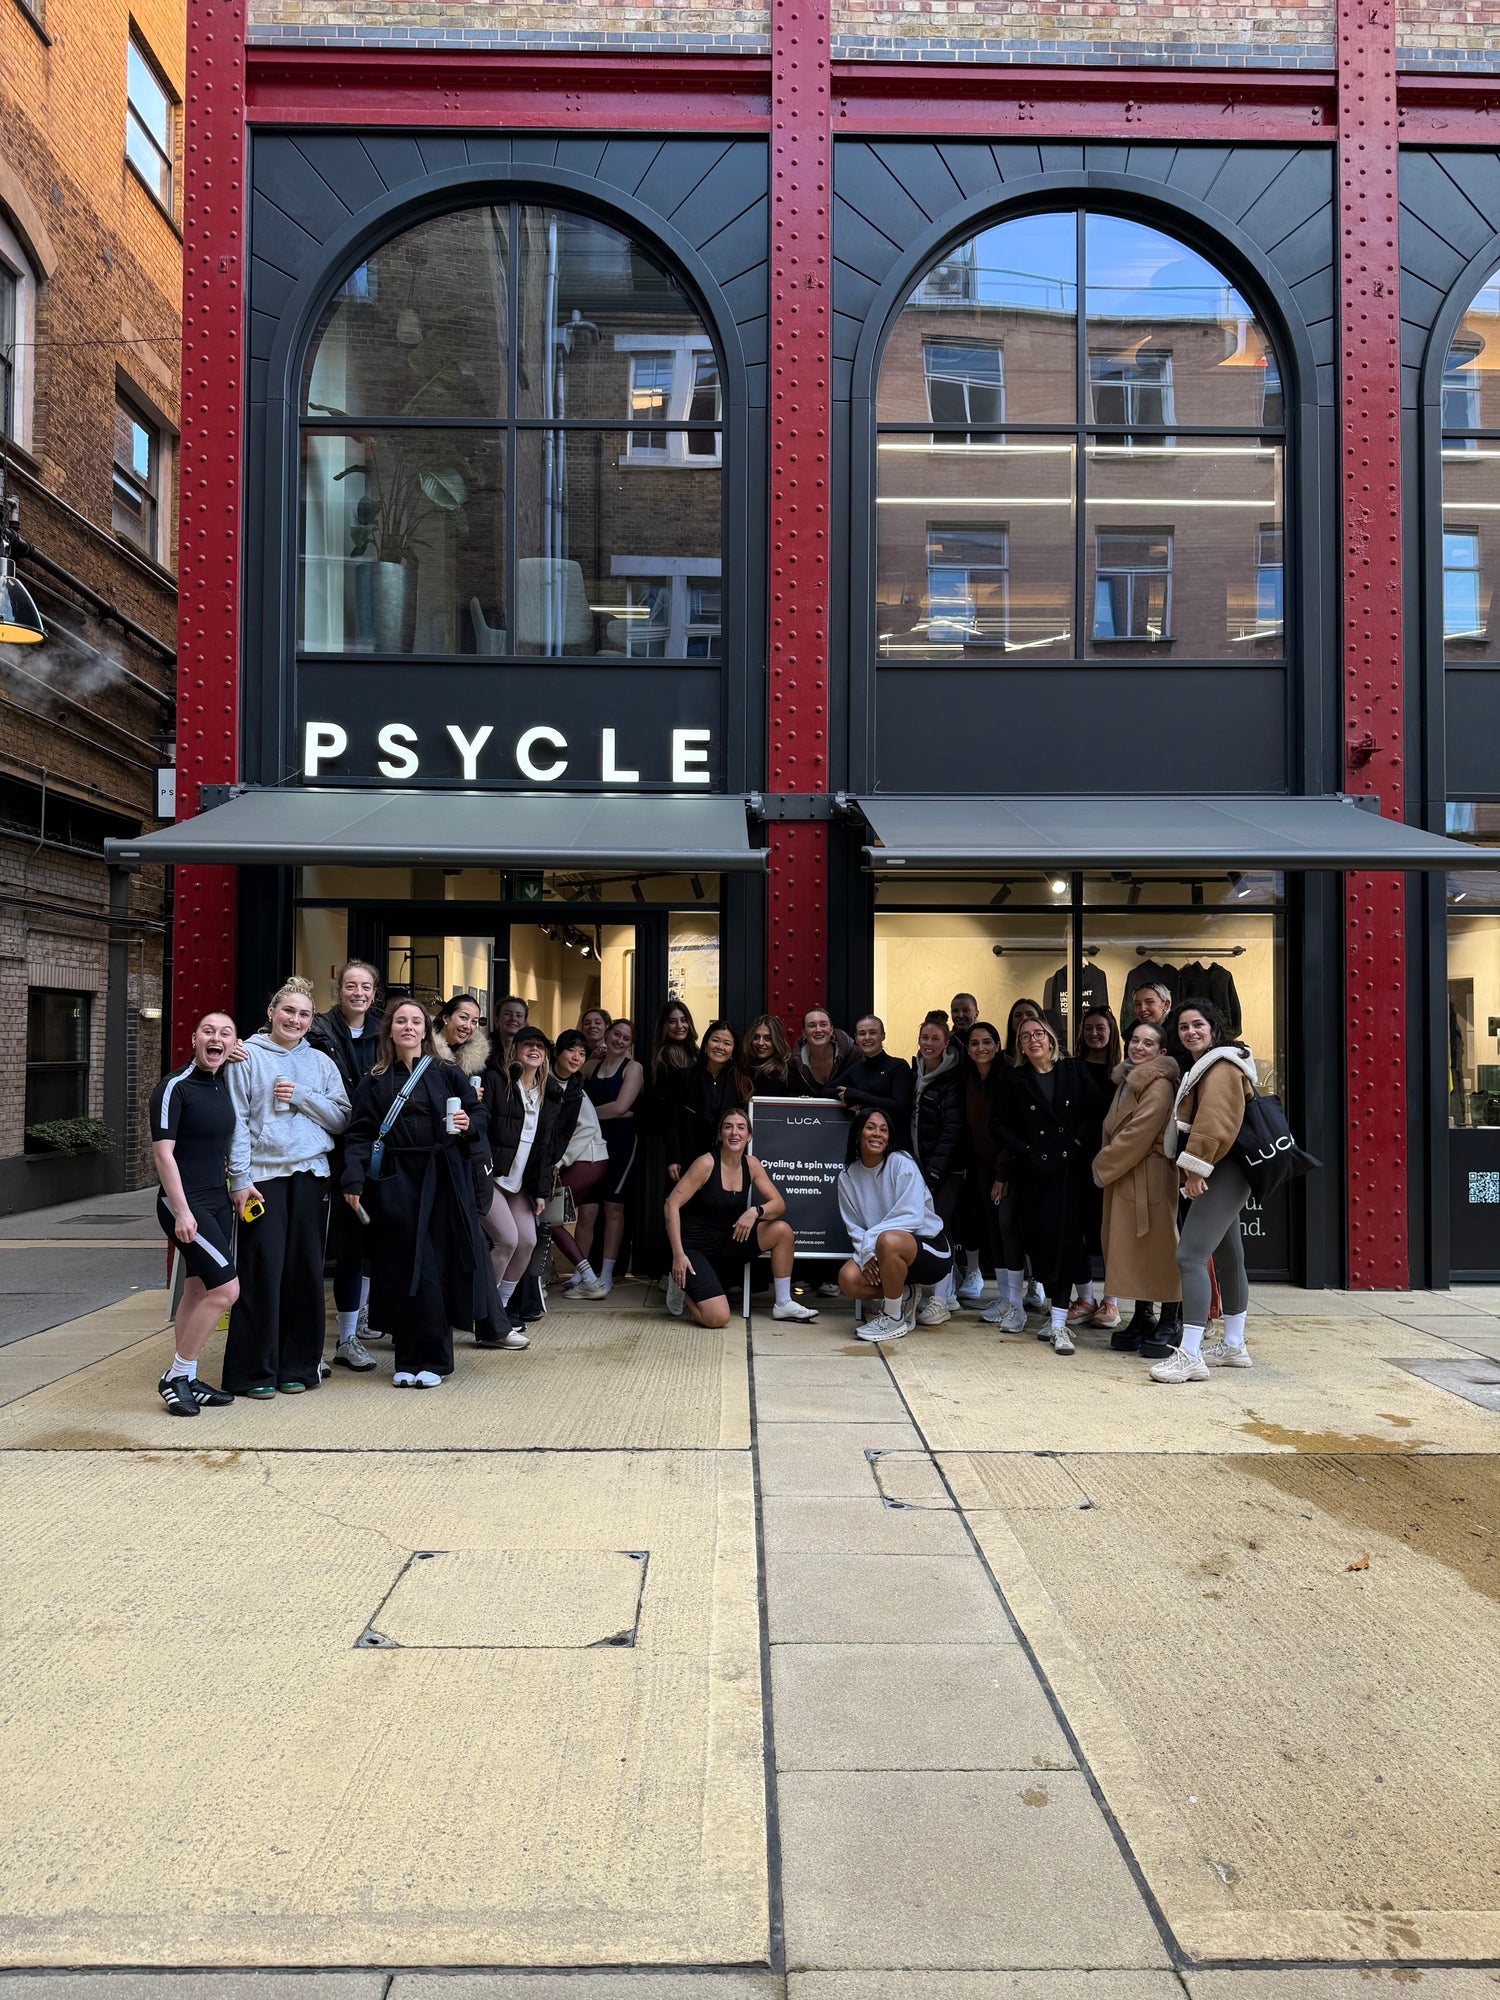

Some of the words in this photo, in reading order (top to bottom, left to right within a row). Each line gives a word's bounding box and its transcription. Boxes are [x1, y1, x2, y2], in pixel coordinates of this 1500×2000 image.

[304, 721, 711, 783] PSYCLE
[786, 1117, 822, 1125] LUCA
[760, 1159, 795, 1170] Cycling
[797, 1160, 803, 1168] &
[804, 1160, 823, 1170] spin
[824, 1162, 845, 1170] wea
[772, 1173, 785, 1181] for
[786, 1174, 822, 1183] women,
[823, 1174, 835, 1183] by
[785, 1187, 822, 1195] women.
